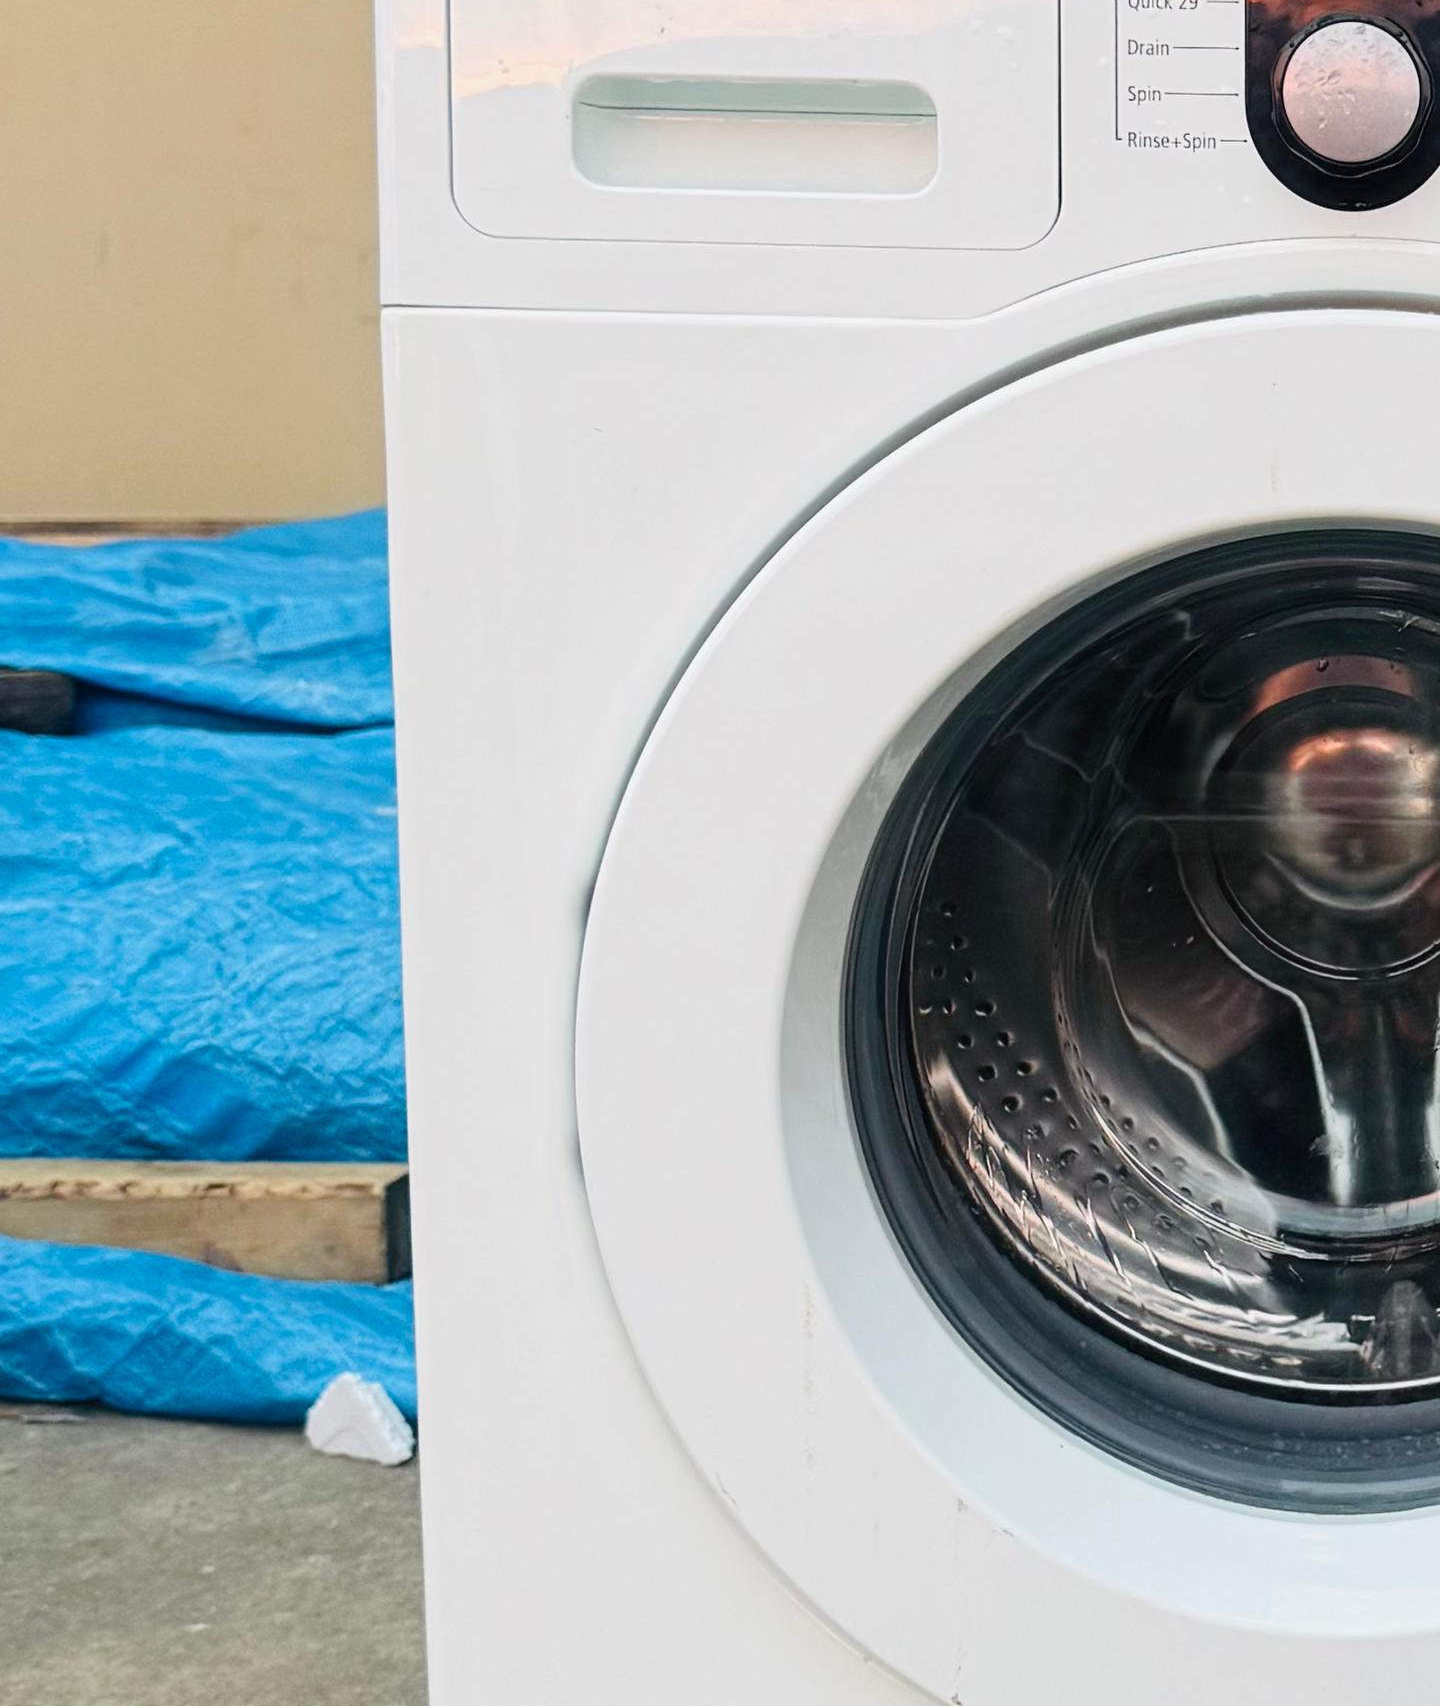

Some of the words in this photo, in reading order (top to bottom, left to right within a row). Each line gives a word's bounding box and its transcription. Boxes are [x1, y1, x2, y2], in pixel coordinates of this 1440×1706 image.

[1126, 40, 1170, 57] Drain
[1127, 86, 1162, 105] Spin
[1126, 132, 1217, 152] Rinse+Spin
